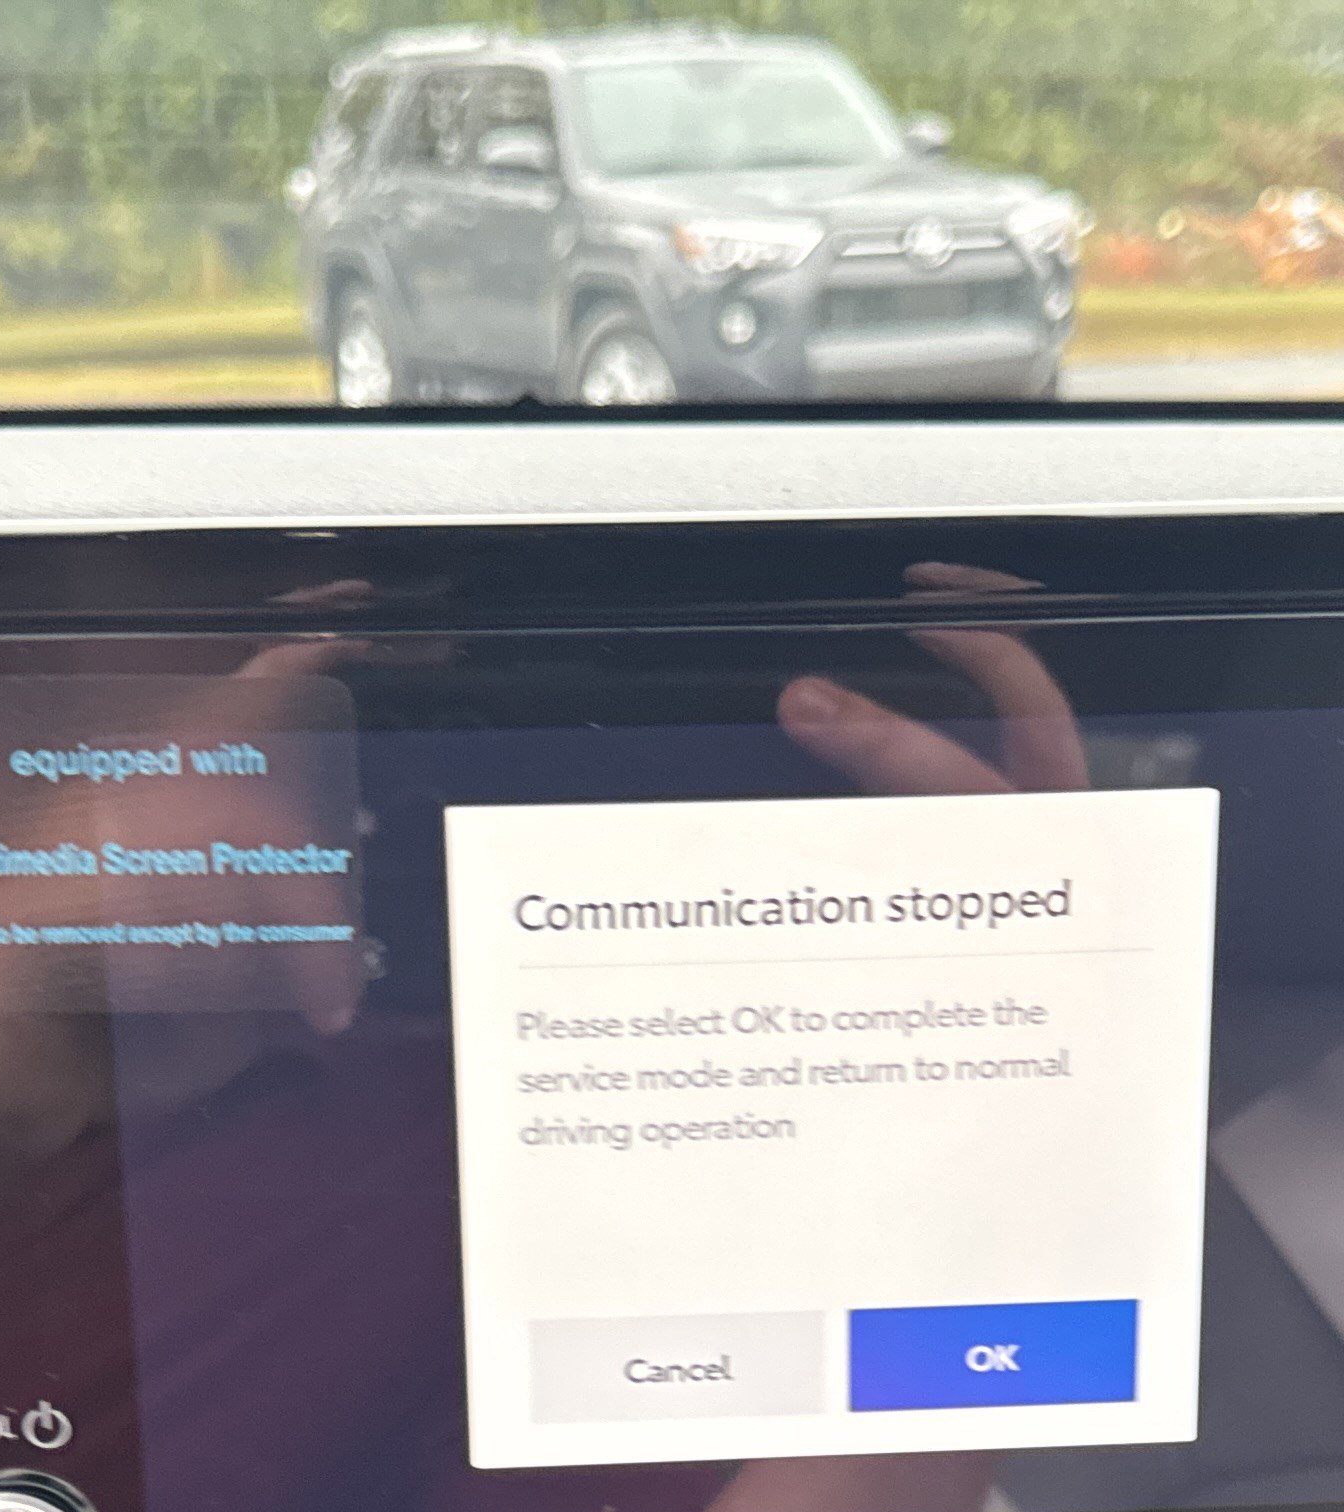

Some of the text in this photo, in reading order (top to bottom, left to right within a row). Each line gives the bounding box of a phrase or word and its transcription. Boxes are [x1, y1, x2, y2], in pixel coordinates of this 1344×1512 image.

[9, 742, 269, 783] equipped with
[100, 842, 208, 875] Screen
[211, 841, 353, 875] Protector
[513, 878, 1074, 933] Communication stopped
[515, 998, 1049, 1041] Please select OK to complete the
[517, 1049, 1072, 1095] service mode and return to normal
[518, 1112, 797, 1152] driving operation
[623, 1344, 1022, 1384] Cancel OK
